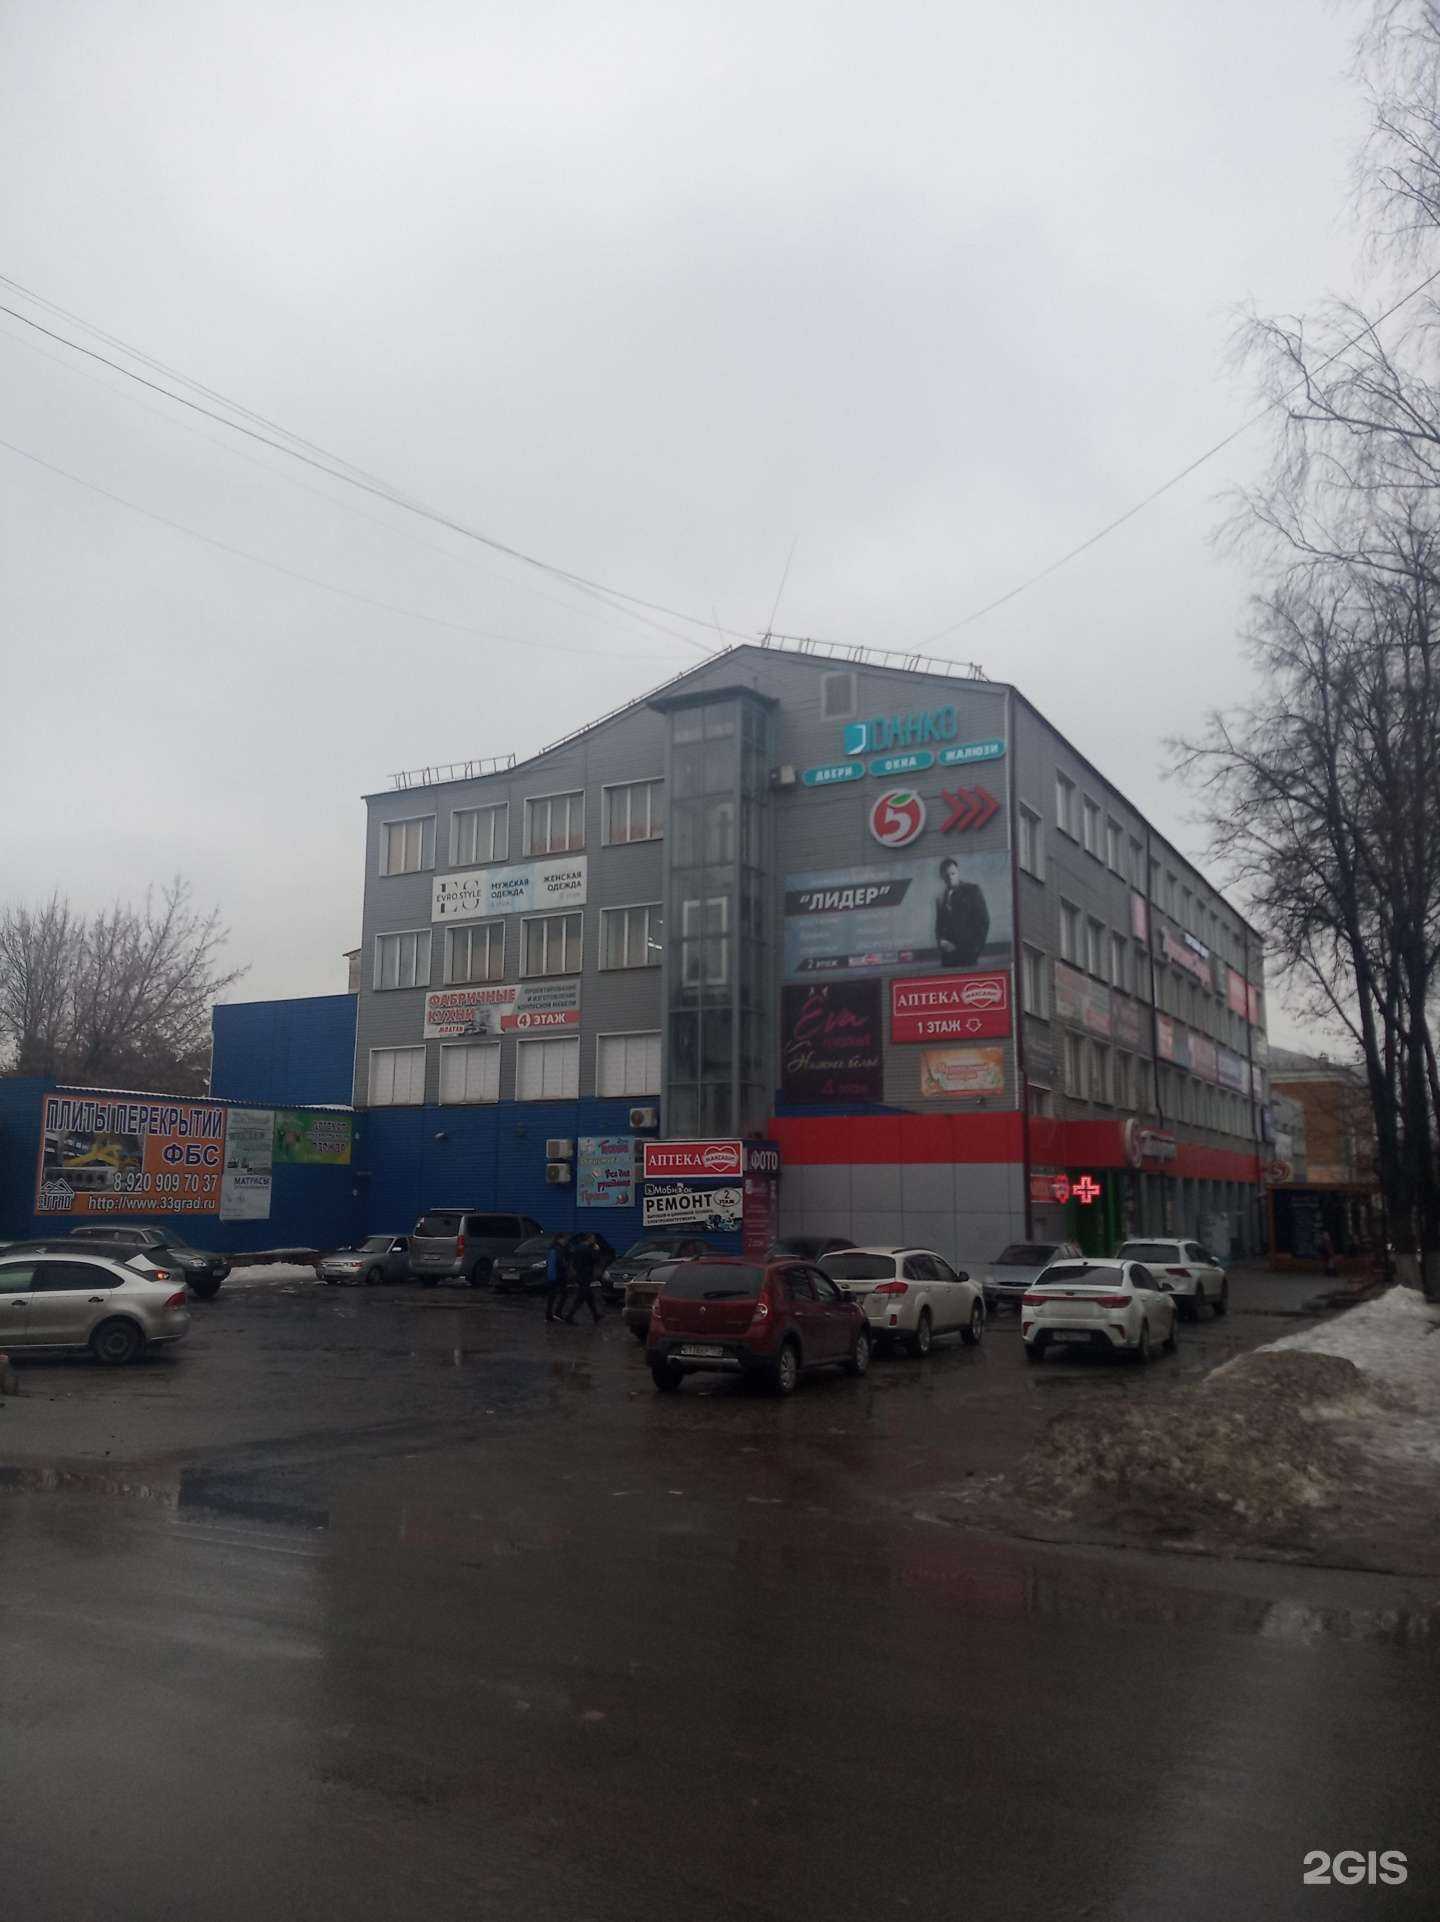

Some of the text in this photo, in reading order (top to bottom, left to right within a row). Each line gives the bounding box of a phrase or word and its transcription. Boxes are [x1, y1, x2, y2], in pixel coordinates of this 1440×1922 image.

[945, 744, 999, 761] ЖАЛЮЗИ
[885, 756, 918, 770] ОКНА
[816, 767, 852, 782] ДВЕРИ
[491, 878, 529, 890] МУЖСКАЯ
[543, 871, 582, 882] ЖЕНСКАЯ
[491, 890, 524, 898] ОДЕЖДА
[547, 881, 582, 892] ОДЕЖДА
[429, 989, 516, 1007] ФАБРИЧНЫЕ
[898, 992, 960, 1007] АПТЕКА
[533, 1013, 567, 1025] ЭТАЖ
[917, 1020, 961, 1034] 1 ЭТАЖ
[46, 1100, 111, 1132] ПЛИТЫ
[114, 1103, 223, 1138] ПЕРЕКРЫТИЙ
[163, 1144, 219, 1167] ФБС
[648, 1153, 702, 1166] АПТЕКА
[751, 1150, 779, 1170] ФОТО
[156, 1173, 179, 1191] 909
[184, 1174, 199, 1192] 70
[203, 1174, 218, 1192] 37
[724, 1190, 730, 1198] 2
[88, 1195, 215, 1212] http://www.33grad.ru
[646, 1194, 712, 1212] РЕМОНТ
